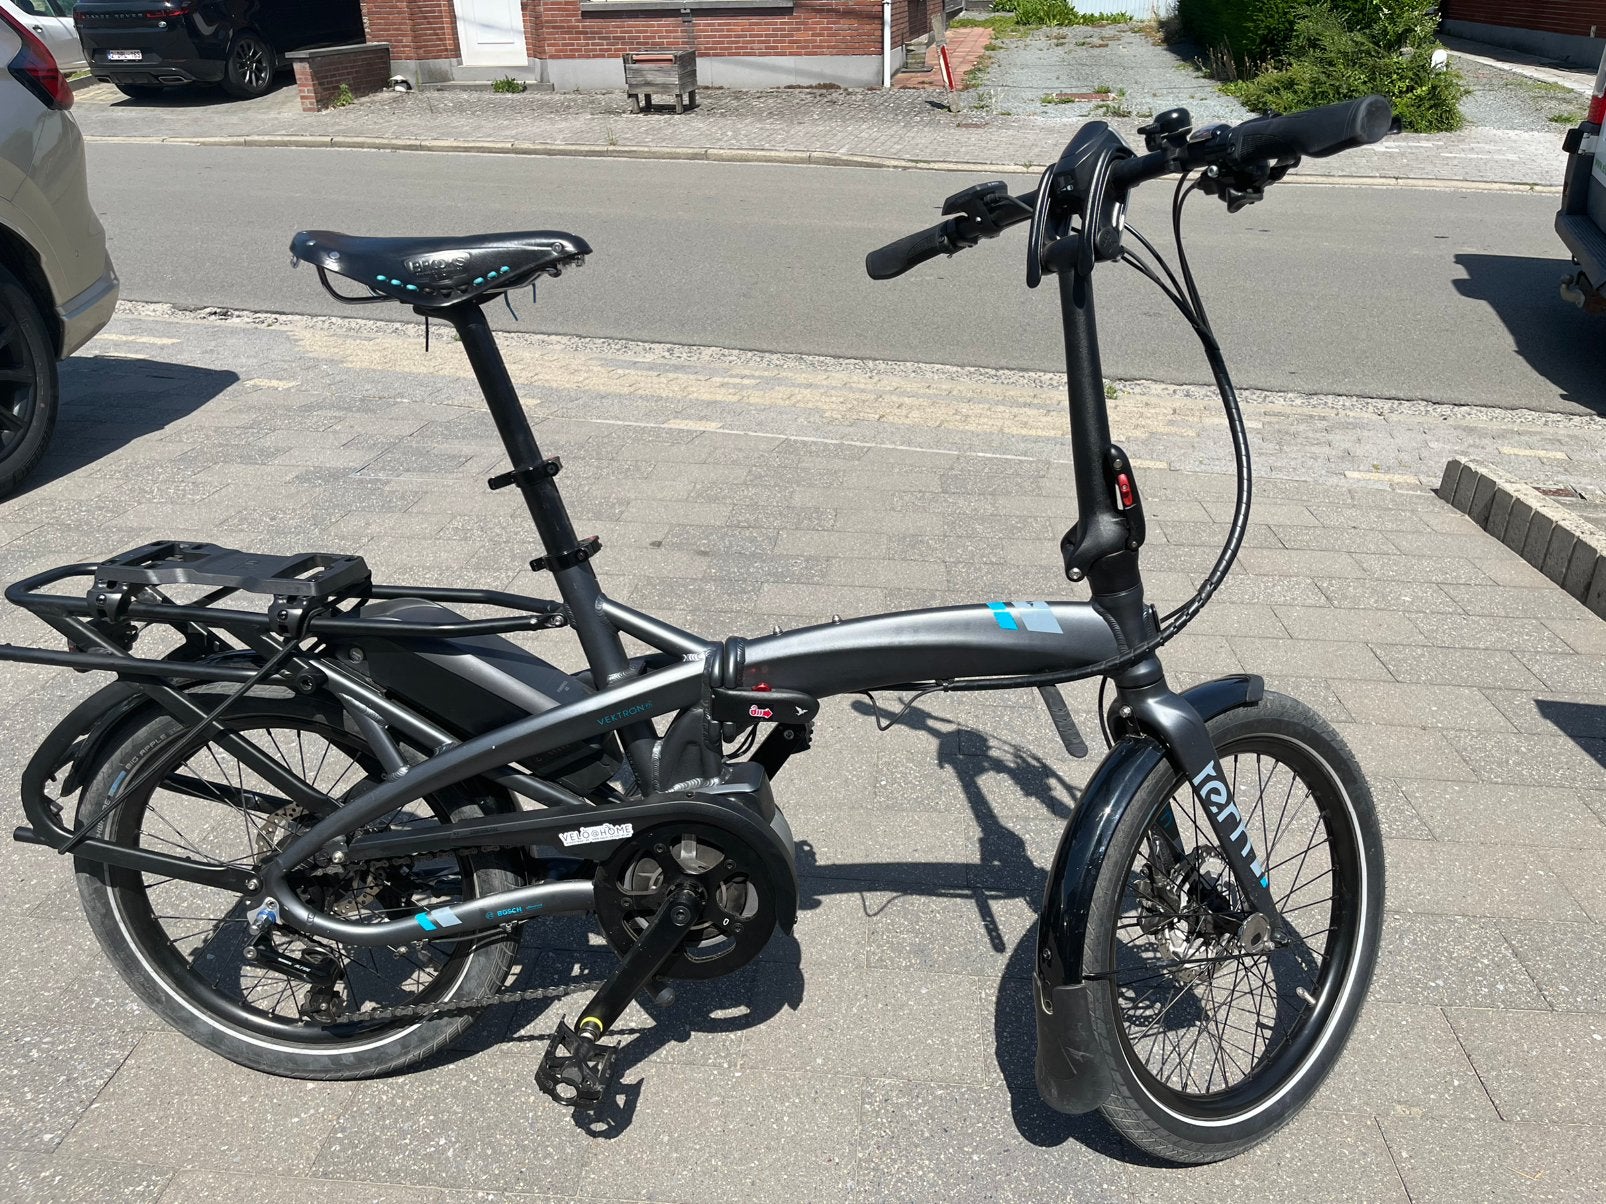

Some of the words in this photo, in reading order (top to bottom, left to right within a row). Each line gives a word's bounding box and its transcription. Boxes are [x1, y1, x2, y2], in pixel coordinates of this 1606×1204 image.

[597, 704, 646, 725] VEKTRON
[125, 756, 139, 770] BIG
[140, 733, 167, 756] APPLE
[497, 906, 522, 917] BOSCH
